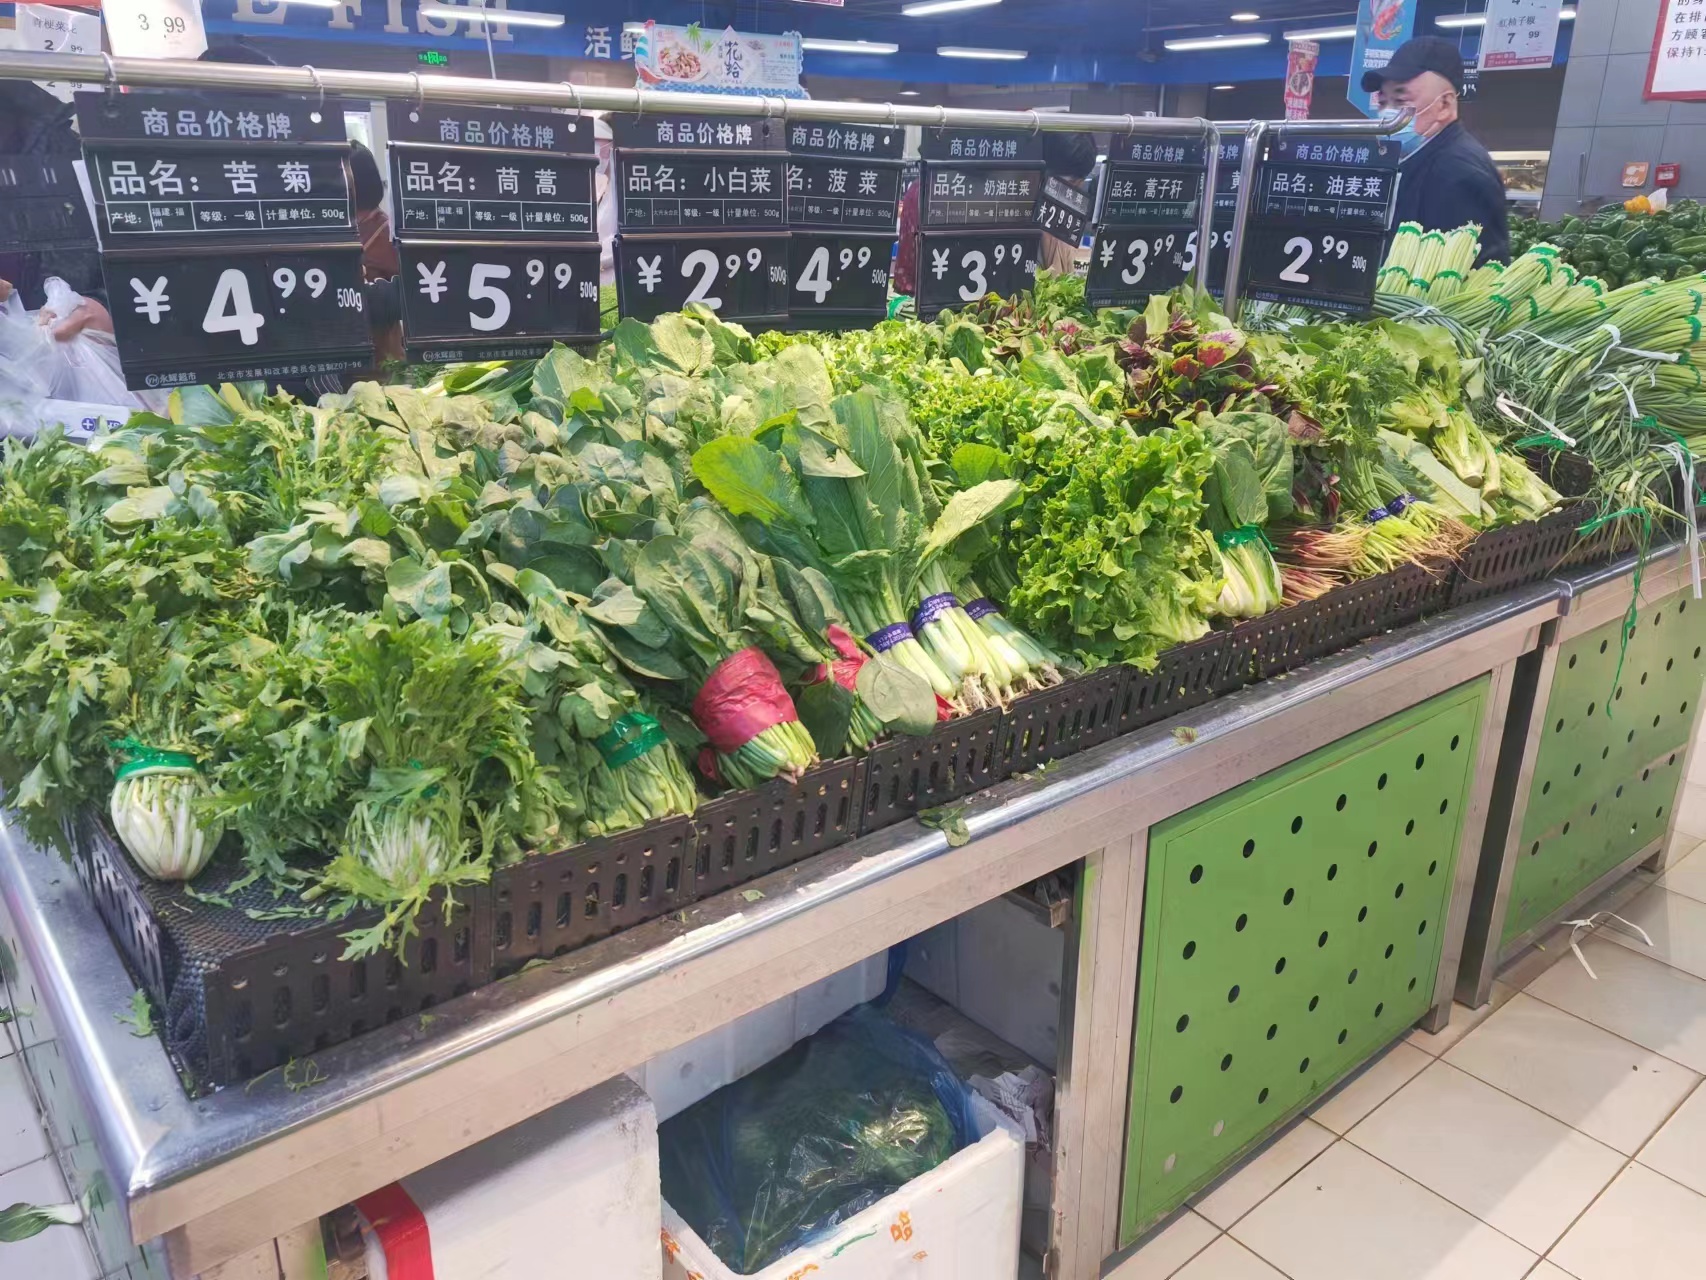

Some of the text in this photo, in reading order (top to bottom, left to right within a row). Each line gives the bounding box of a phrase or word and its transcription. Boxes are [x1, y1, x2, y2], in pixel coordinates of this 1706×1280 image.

[1674, 11, 1706, 24] 在排
[141, 107, 292, 139] 商品价格牌
[439, 117, 555, 149] 商品价格牌
[657, 120, 752, 146] 商品价格牌
[792, 126, 875, 152] 商品价格牌
[951, 137, 1017, 158] 商品价格牌
[1132, 144, 1184, 163] 商品价格牌
[1296, 143, 1370, 164] 商品价格牌
[1352, 256, 1367, 273] 500g
[770, 266, 787, 285] 500g
[871, 269, 887, 287] 500g
[336, 288, 363, 313] 500g
[579, 281, 598, 303] 500g
